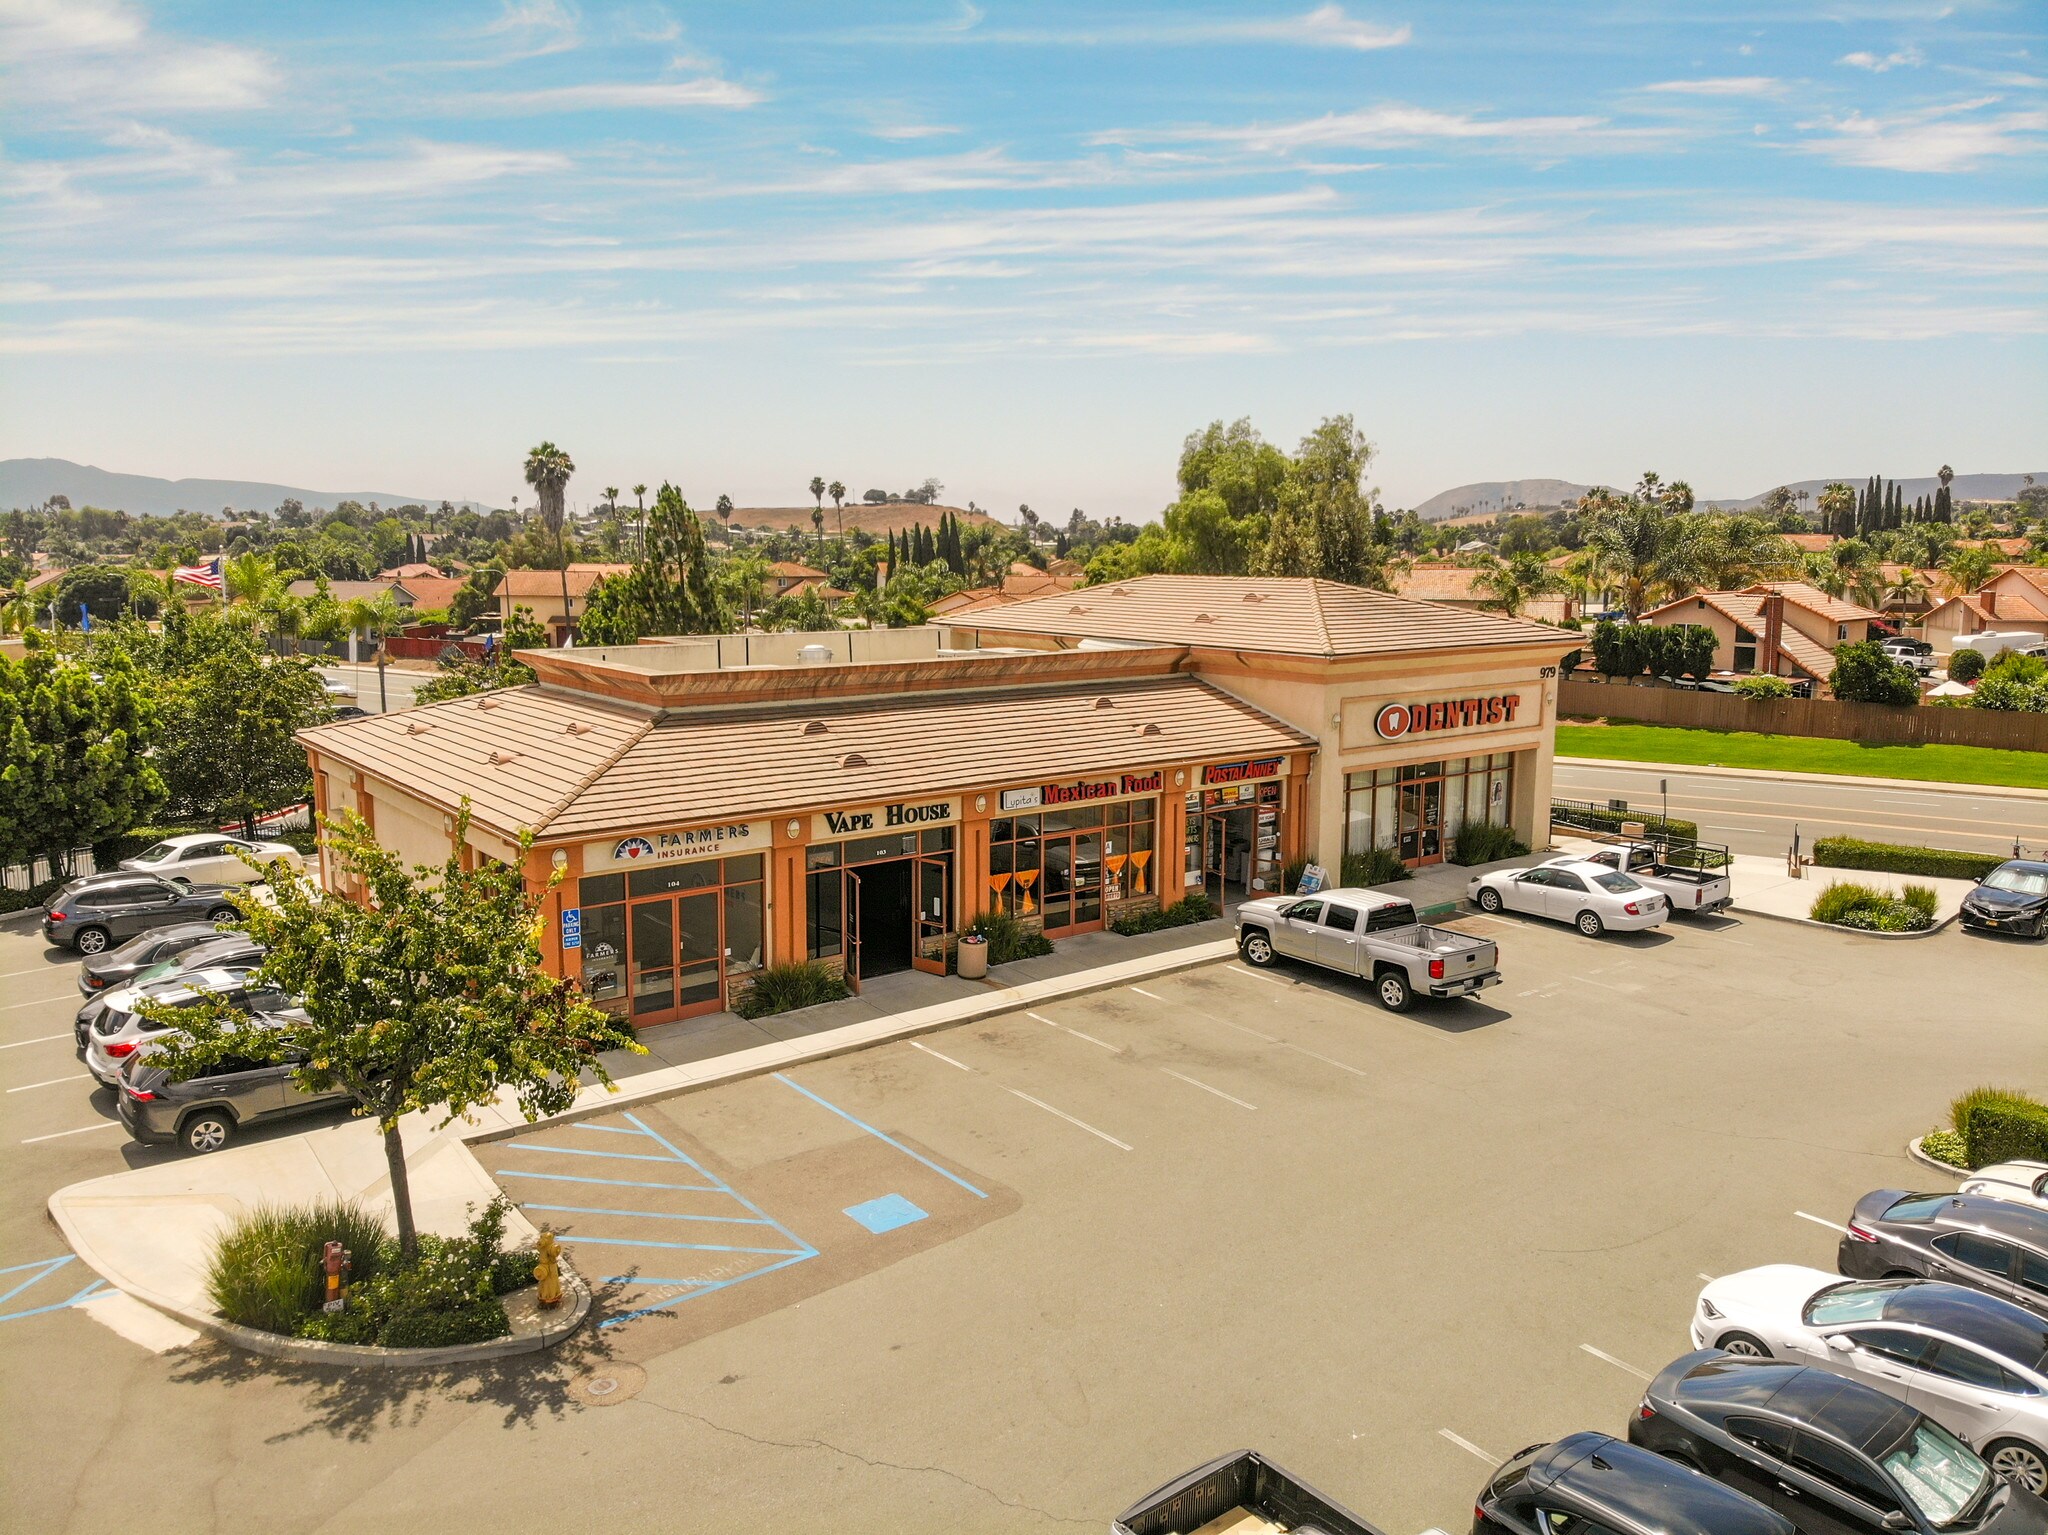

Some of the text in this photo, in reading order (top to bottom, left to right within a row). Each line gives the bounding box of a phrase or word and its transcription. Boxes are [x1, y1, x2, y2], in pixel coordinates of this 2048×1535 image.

[1540, 667, 1556, 679] 979
[1410, 695, 1520, 733] DENTIST
[1043, 772, 1162, 805] Mexican Food
[1005, 792, 1038, 809] Lupita's
[824, 803, 950, 834] VAPE HOUSE
[659, 825, 750, 848] FARMERS
[657, 844, 720, 859] INSURANCE
[586, 949, 619, 959] FARMERS
